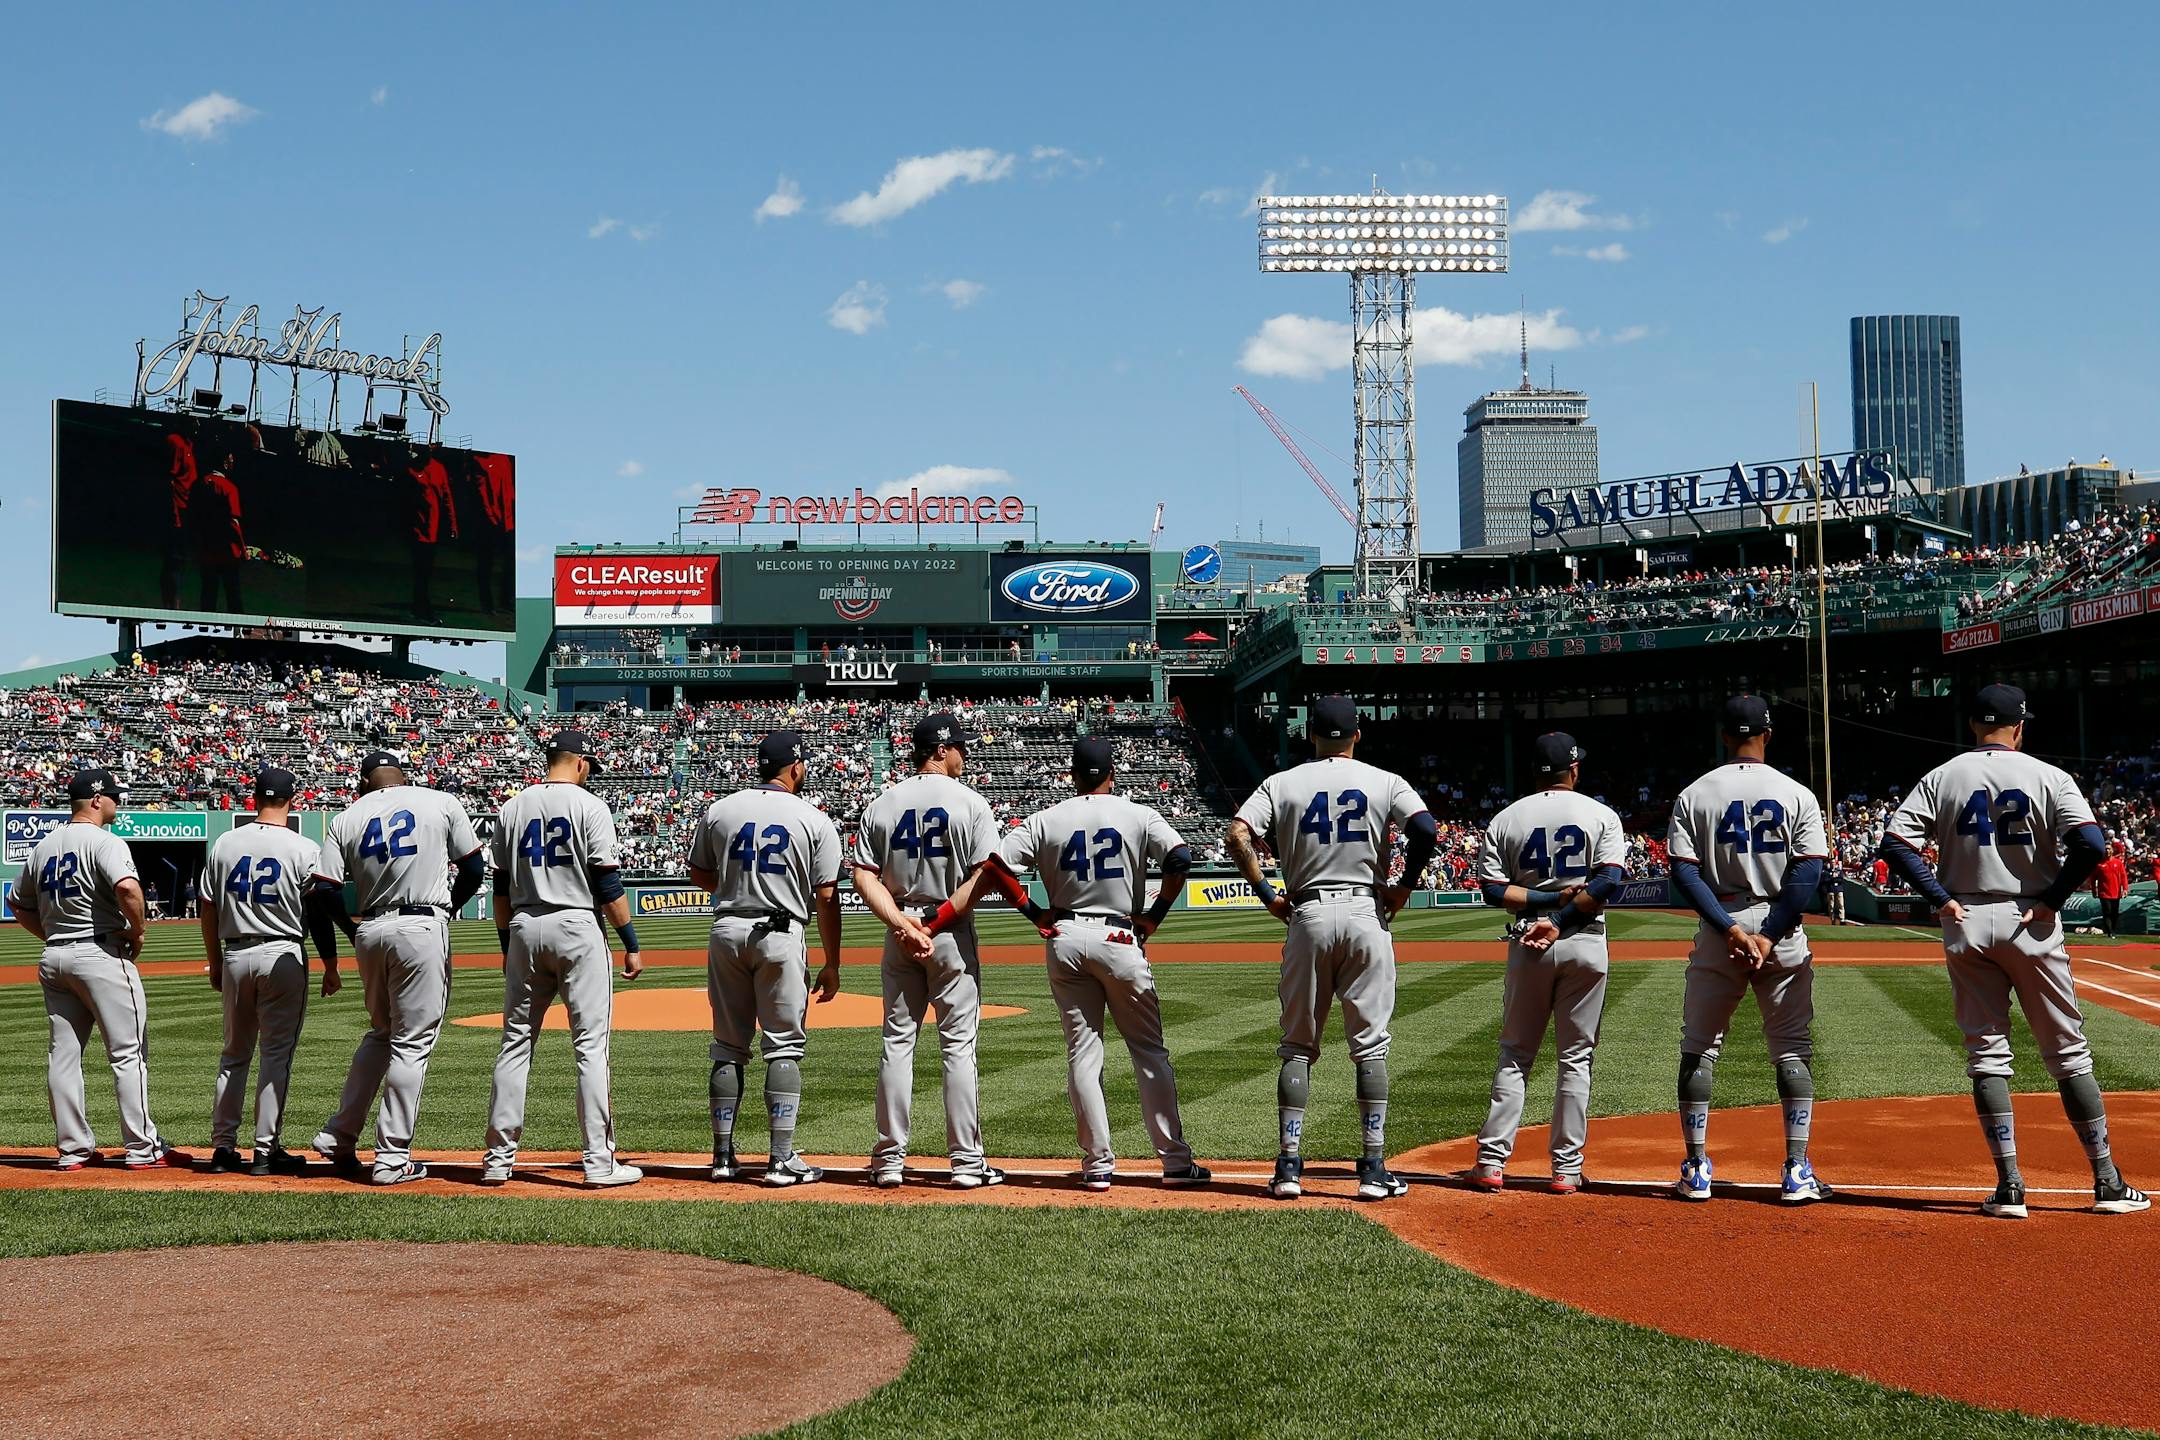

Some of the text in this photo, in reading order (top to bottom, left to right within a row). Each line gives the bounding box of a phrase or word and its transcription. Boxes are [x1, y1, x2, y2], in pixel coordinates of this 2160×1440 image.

[139, 289, 450, 416] John Hancock
[769, 496, 849, 523] new
[855, 487, 1024, 523] balance
[1530, 452, 1895, 538] SAMUEL ADAMS
[756, 559, 956, 570] WELCOME TO OPENING DAY 2022
[1649, 556, 1665, 566] SAM
[1667, 554, 1689, 563] DECK
[571, 565, 705, 585] CLEAResult
[574, 588, 586, 596] We
[612, 588, 624, 596] the
[640, 588, 662, 597] people
[819, 588, 893, 600] OPENING DAY
[1029, 569, 1111, 602] Ford
[1867, 608, 1937, 620] CURRENT JACKPOT
[2072, 593, 2138, 624] CRAFTSMAN
[275, 619, 344, 631] MITSUBISHI ELECTRIC
[2004, 608, 2064, 632] BUILDERS GIN
[1496, 632, 1656, 660] 14 45 26 34 42
[1950, 629, 1994, 650] Sal's PIZZA
[1316, 646, 1472, 664] 9 4 1 8 27 6
[617, 669, 732, 679] 2022 BOSTON RED SOX
[825, 662, 898, 680] TRULY
[982, 666, 1101, 676] SPORTS MEDICINE STAFF
[7, 819, 26, 834] Dr.
[1299, 789, 1369, 844] 42
[1717, 799, 1785, 853] 42
[1956, 788, 2033, 846] 42
[133, 823, 202, 837] sunovion
[359, 809, 418, 864] 42
[890, 807, 951, 859] 42
[519, 816, 574, 867] 42
[729, 822, 790, 875] 42
[1519, 824, 1588, 879] 42
[1060, 827, 1125, 881] 42
[40, 851, 81, 900] 42
[226, 855, 282, 904] 42
[640, 891, 711, 910] GRANITE
[980, 892, 1002, 901] ealth
[1618, 883, 1662, 904] Jordan's
[1888, 904, 1911, 913] SAFELITE
[714, 1106, 733, 1121] 42
[770, 1102, 795, 1118] 42
[1686, 1112, 1706, 1128] 42
[1787, 1110, 1808, 1126] 42
[1286, 1120, 1301, 1137] 42
